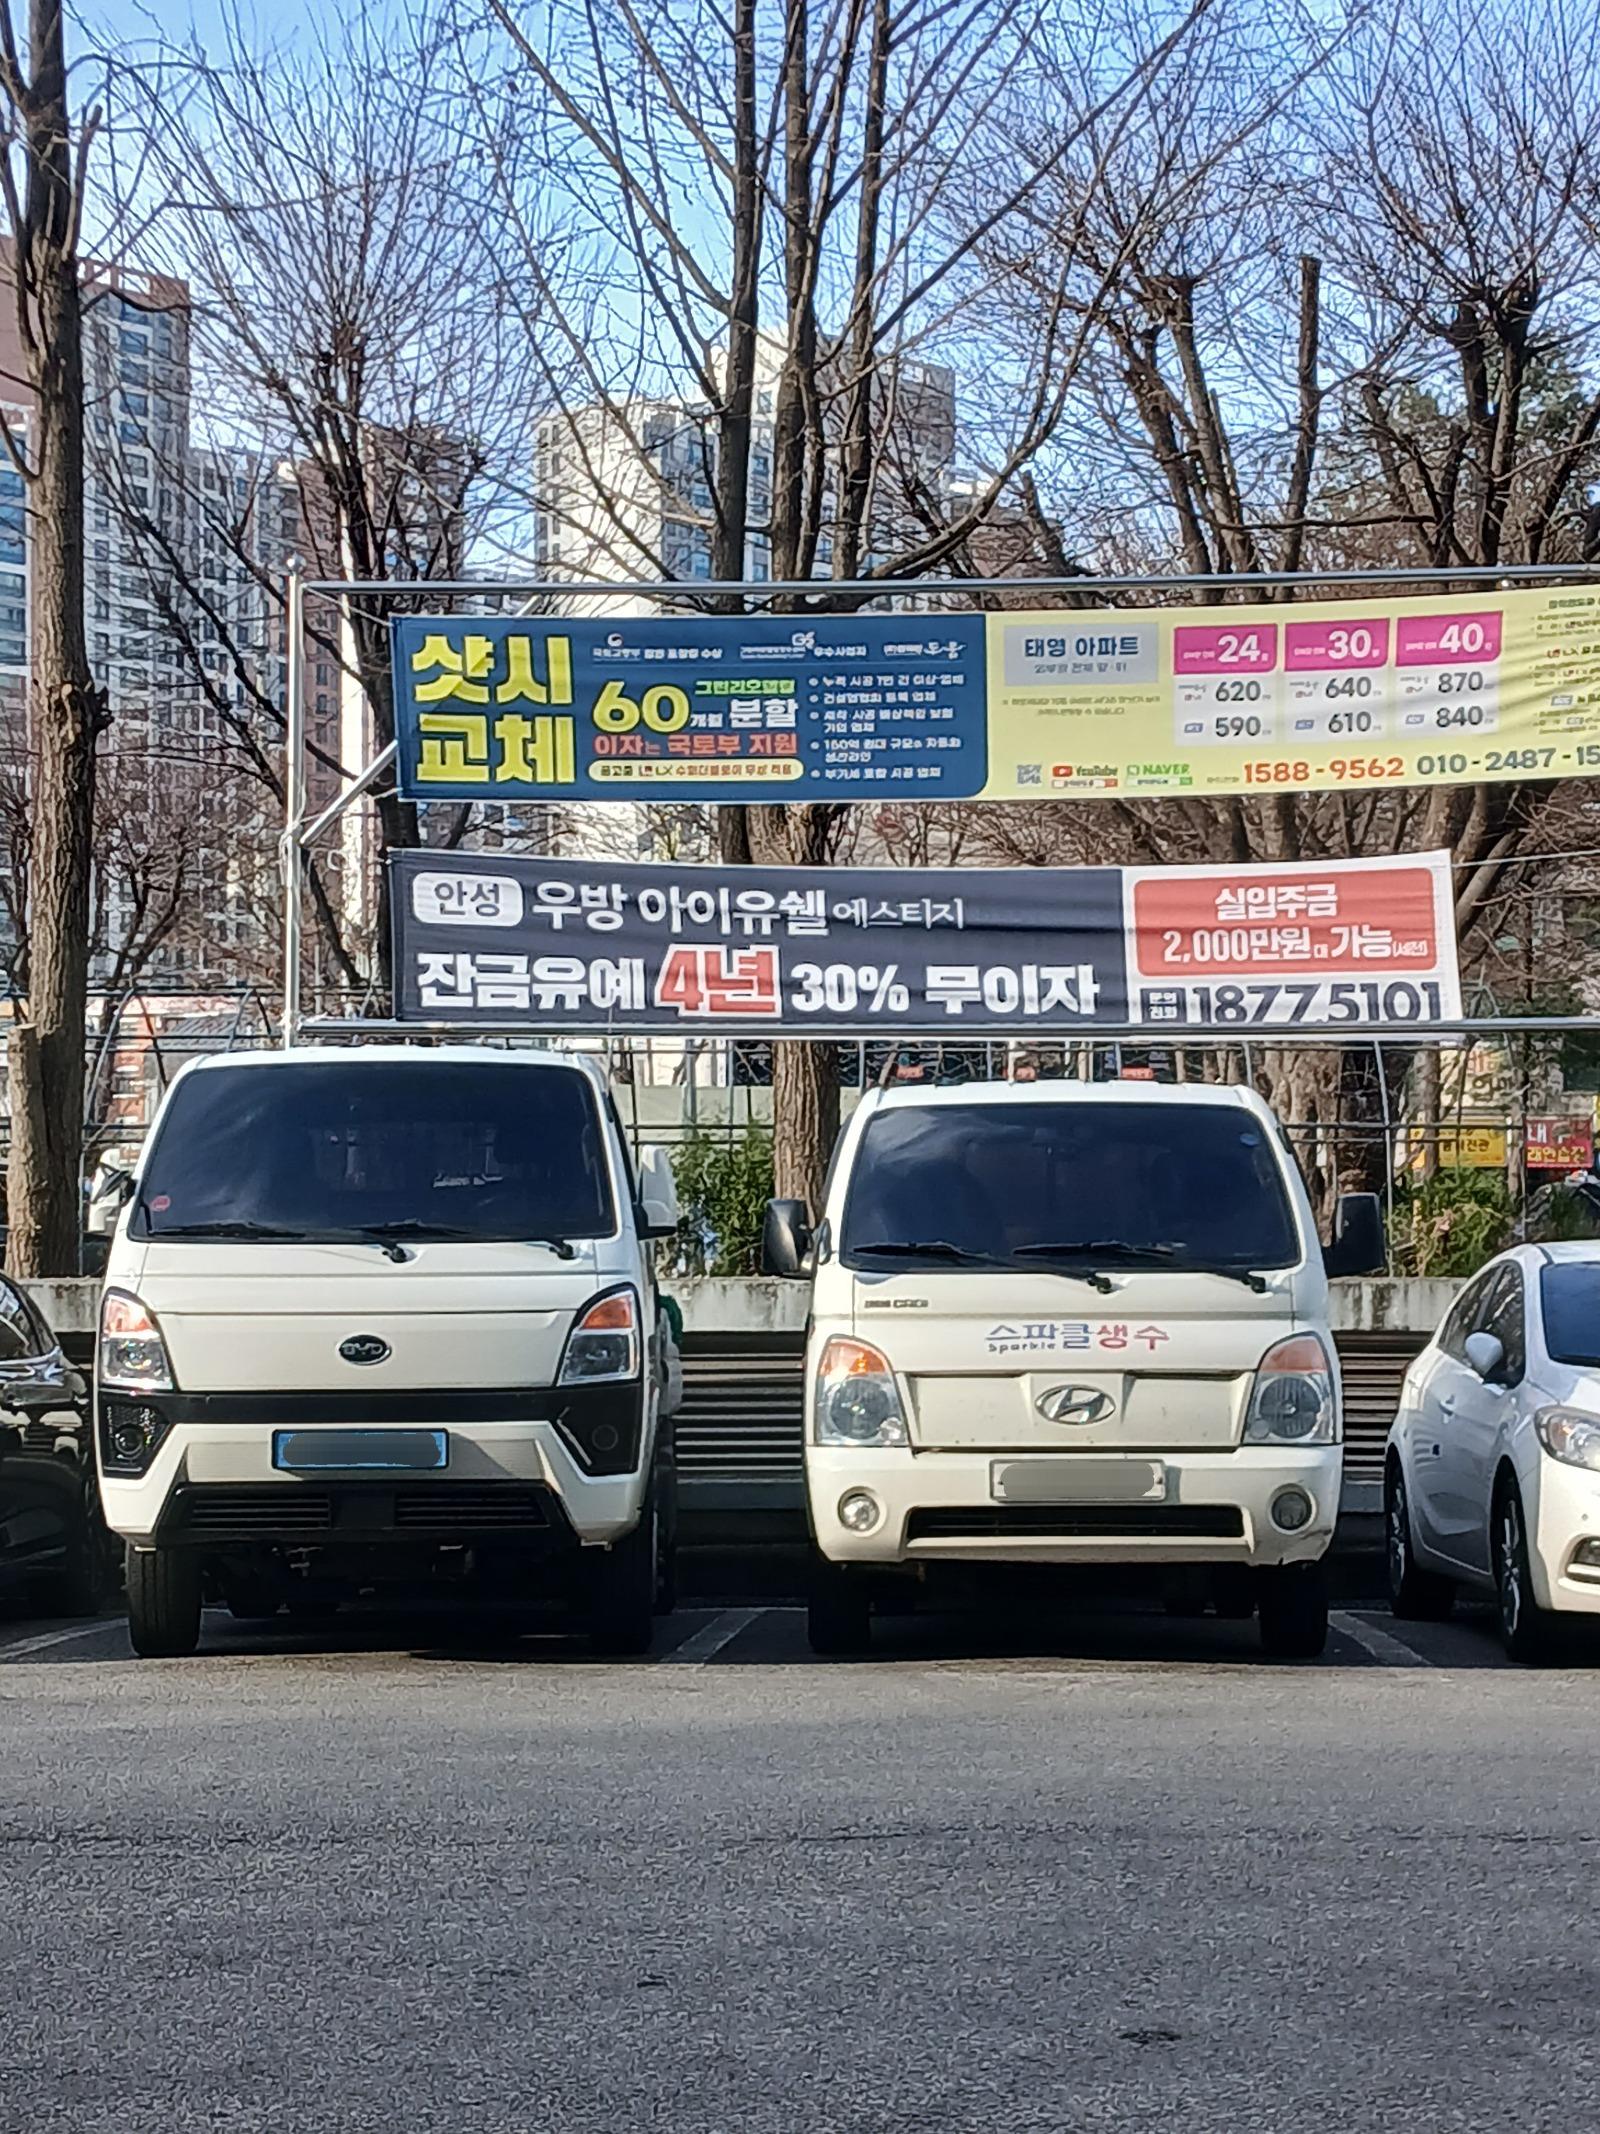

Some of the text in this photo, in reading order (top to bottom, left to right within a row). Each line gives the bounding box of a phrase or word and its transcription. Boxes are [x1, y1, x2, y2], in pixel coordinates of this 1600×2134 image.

[1024, 635, 1139, 658] 태영 아파트
[412, 635, 572, 704] 샷시
[1215, 680, 1262, 702] 620
[1325, 676, 1373, 699] 640
[1438, 671, 1485, 694] 870
[729, 698, 799, 728] 분할
[1328, 711, 1373, 734] 610
[1436, 706, 1484, 729] 840
[1215, 715, 1263, 738] 590
[417, 712, 575, 783] 교체
[594, 733, 798, 756] 이자는 국토부 지원
[1143, 763, 1190, 776] NAVER
[434, 881, 965, 936] 안성 우방 아이유쉘 에스티지
[1215, 883, 1338, 921] 실입주금
[1331, 925, 1392, 960] 가능
[417, 945, 1099, 1016] 잔금유예 4년 30% 무이자
[985, 1323, 1170, 1351] 스파클생수
[988, 1341, 1056, 1354] Sparkle
